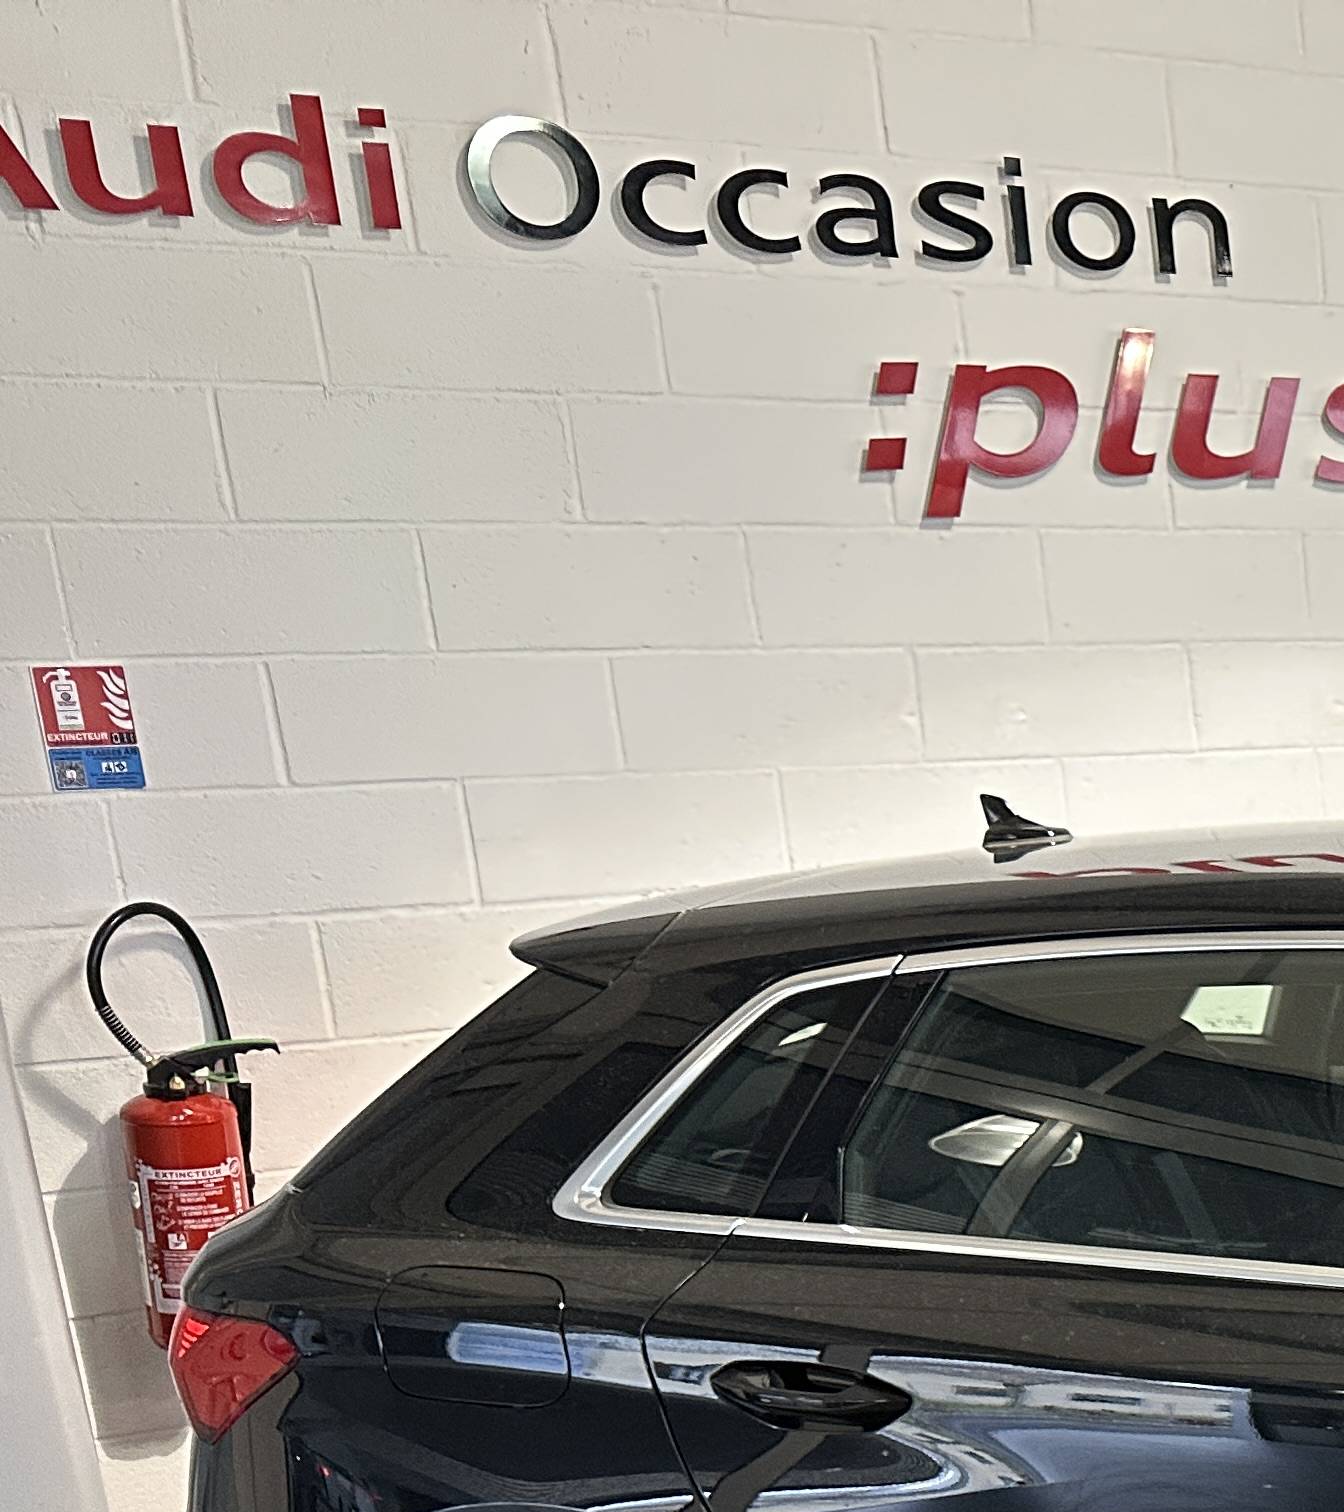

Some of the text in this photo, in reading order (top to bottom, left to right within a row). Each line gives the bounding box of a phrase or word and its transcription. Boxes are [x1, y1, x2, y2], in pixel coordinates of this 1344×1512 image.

[466, 115, 1233, 277] Occasion
[47, 732, 109, 742] EXTINCTEUR
[154, 1168, 222, 1178] EXTINCTEUR
